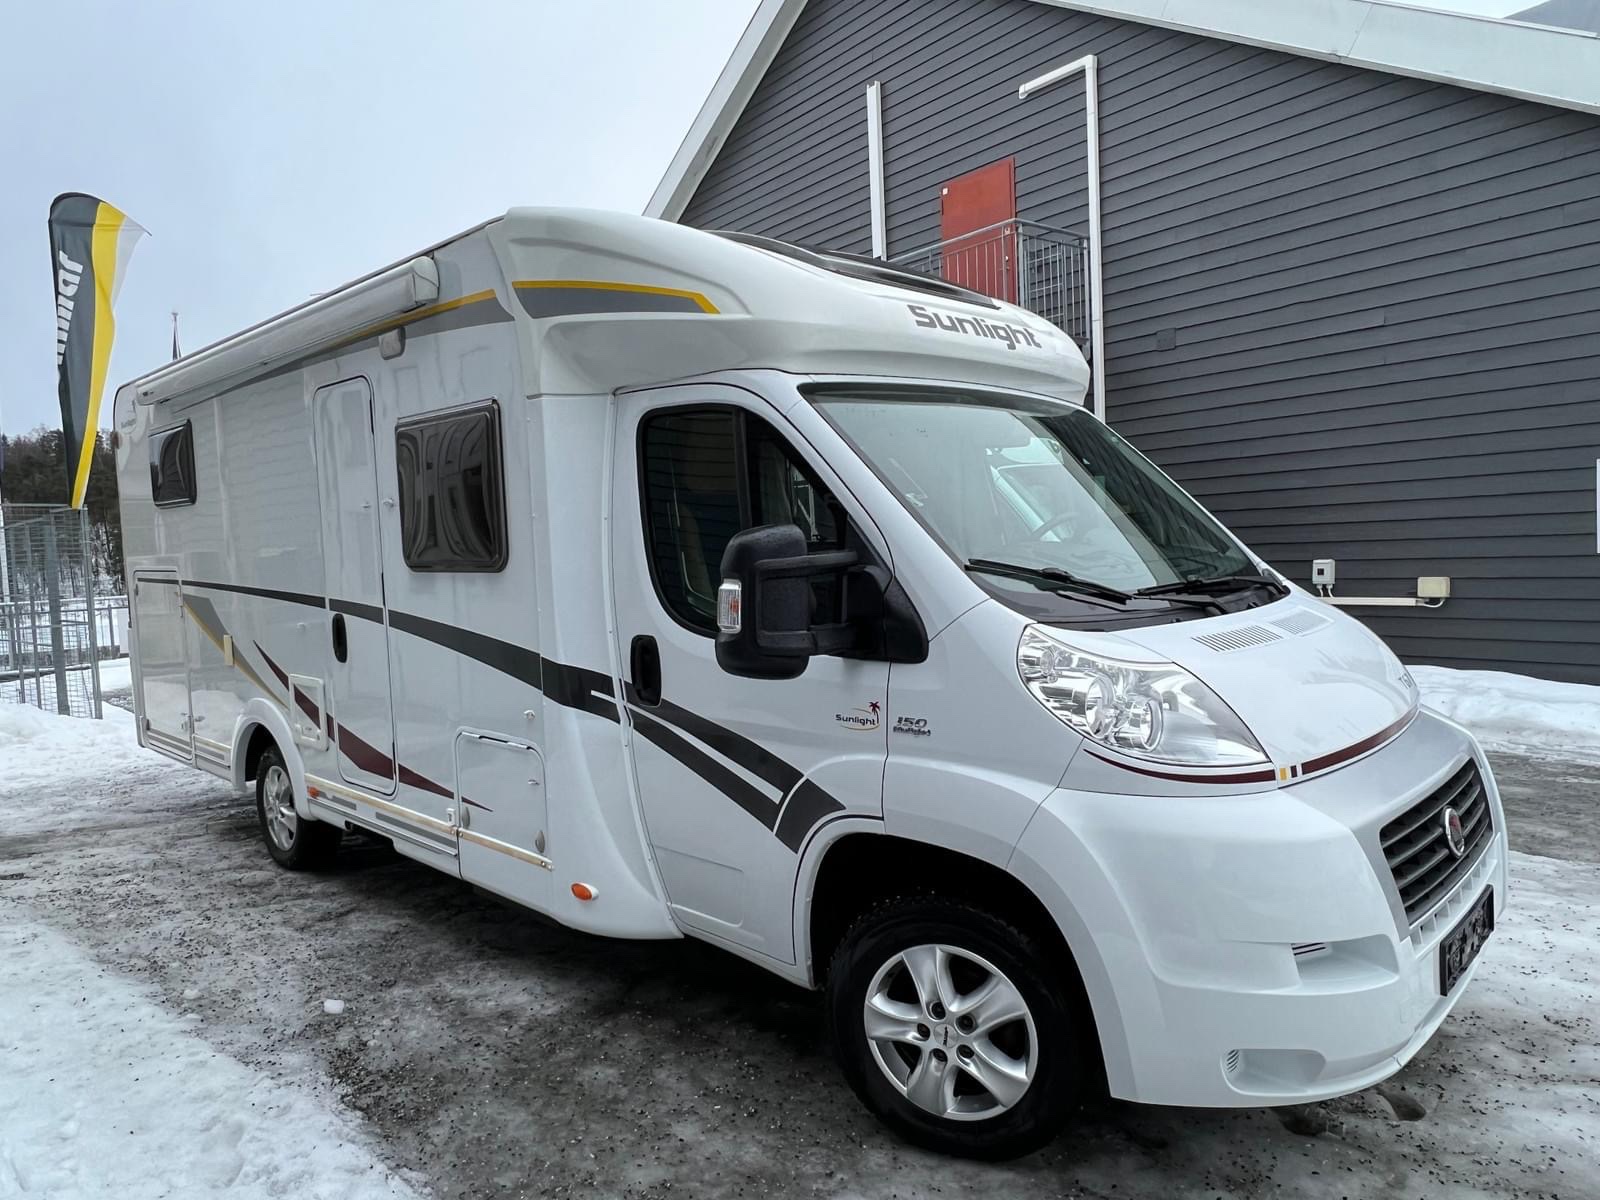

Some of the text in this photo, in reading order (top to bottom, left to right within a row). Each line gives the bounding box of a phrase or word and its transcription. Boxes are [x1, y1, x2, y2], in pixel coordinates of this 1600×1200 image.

[907, 304, 1042, 350] Sunlight
[835, 714, 876, 726] Sunlight
[897, 716, 927, 728] 150
